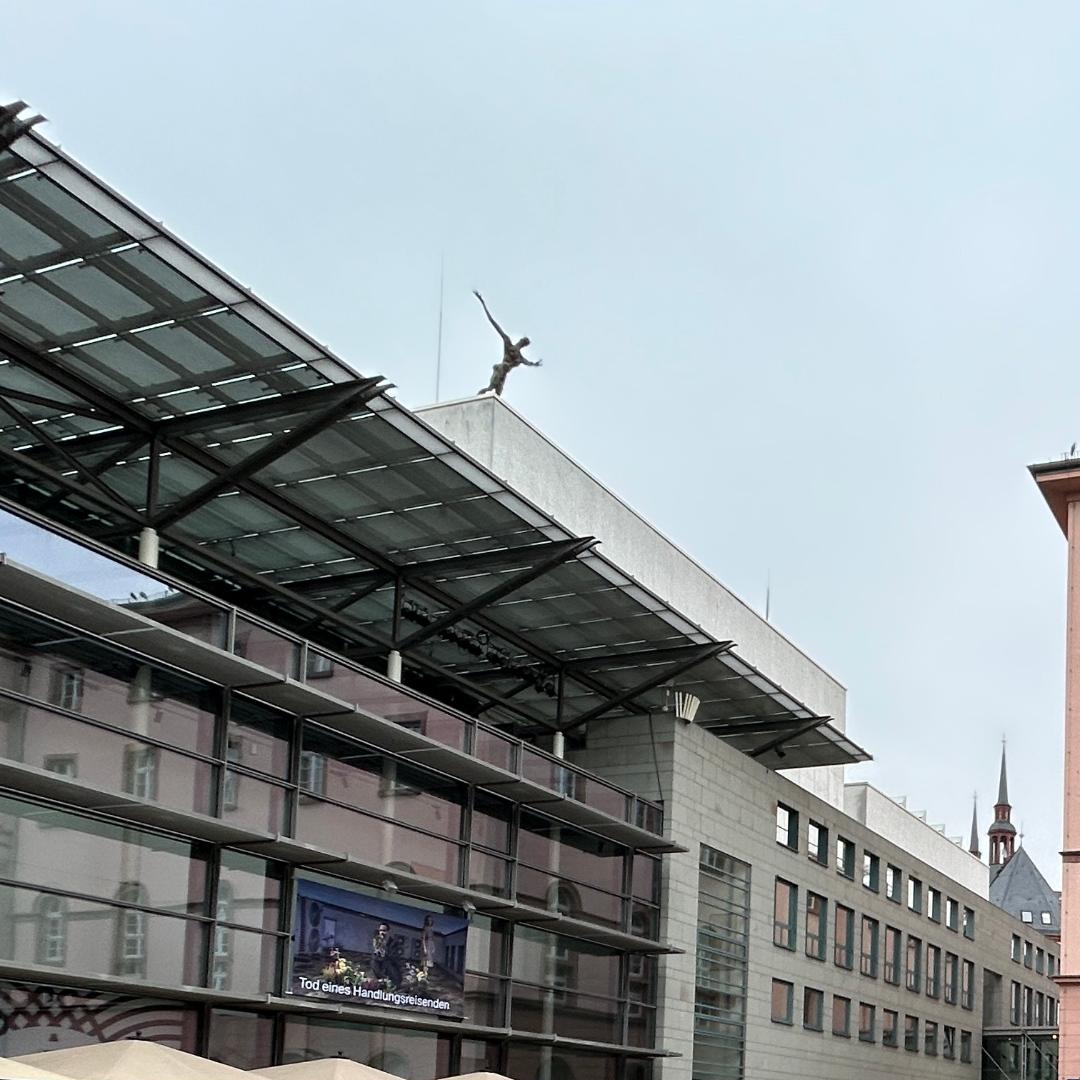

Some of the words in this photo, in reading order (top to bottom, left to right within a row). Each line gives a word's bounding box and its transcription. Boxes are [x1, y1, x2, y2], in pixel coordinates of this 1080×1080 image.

[299, 977, 320, 991] Tod
[322, 983, 351, 996] eines
[353, 986, 450, 1010] Handlungsreisenden
